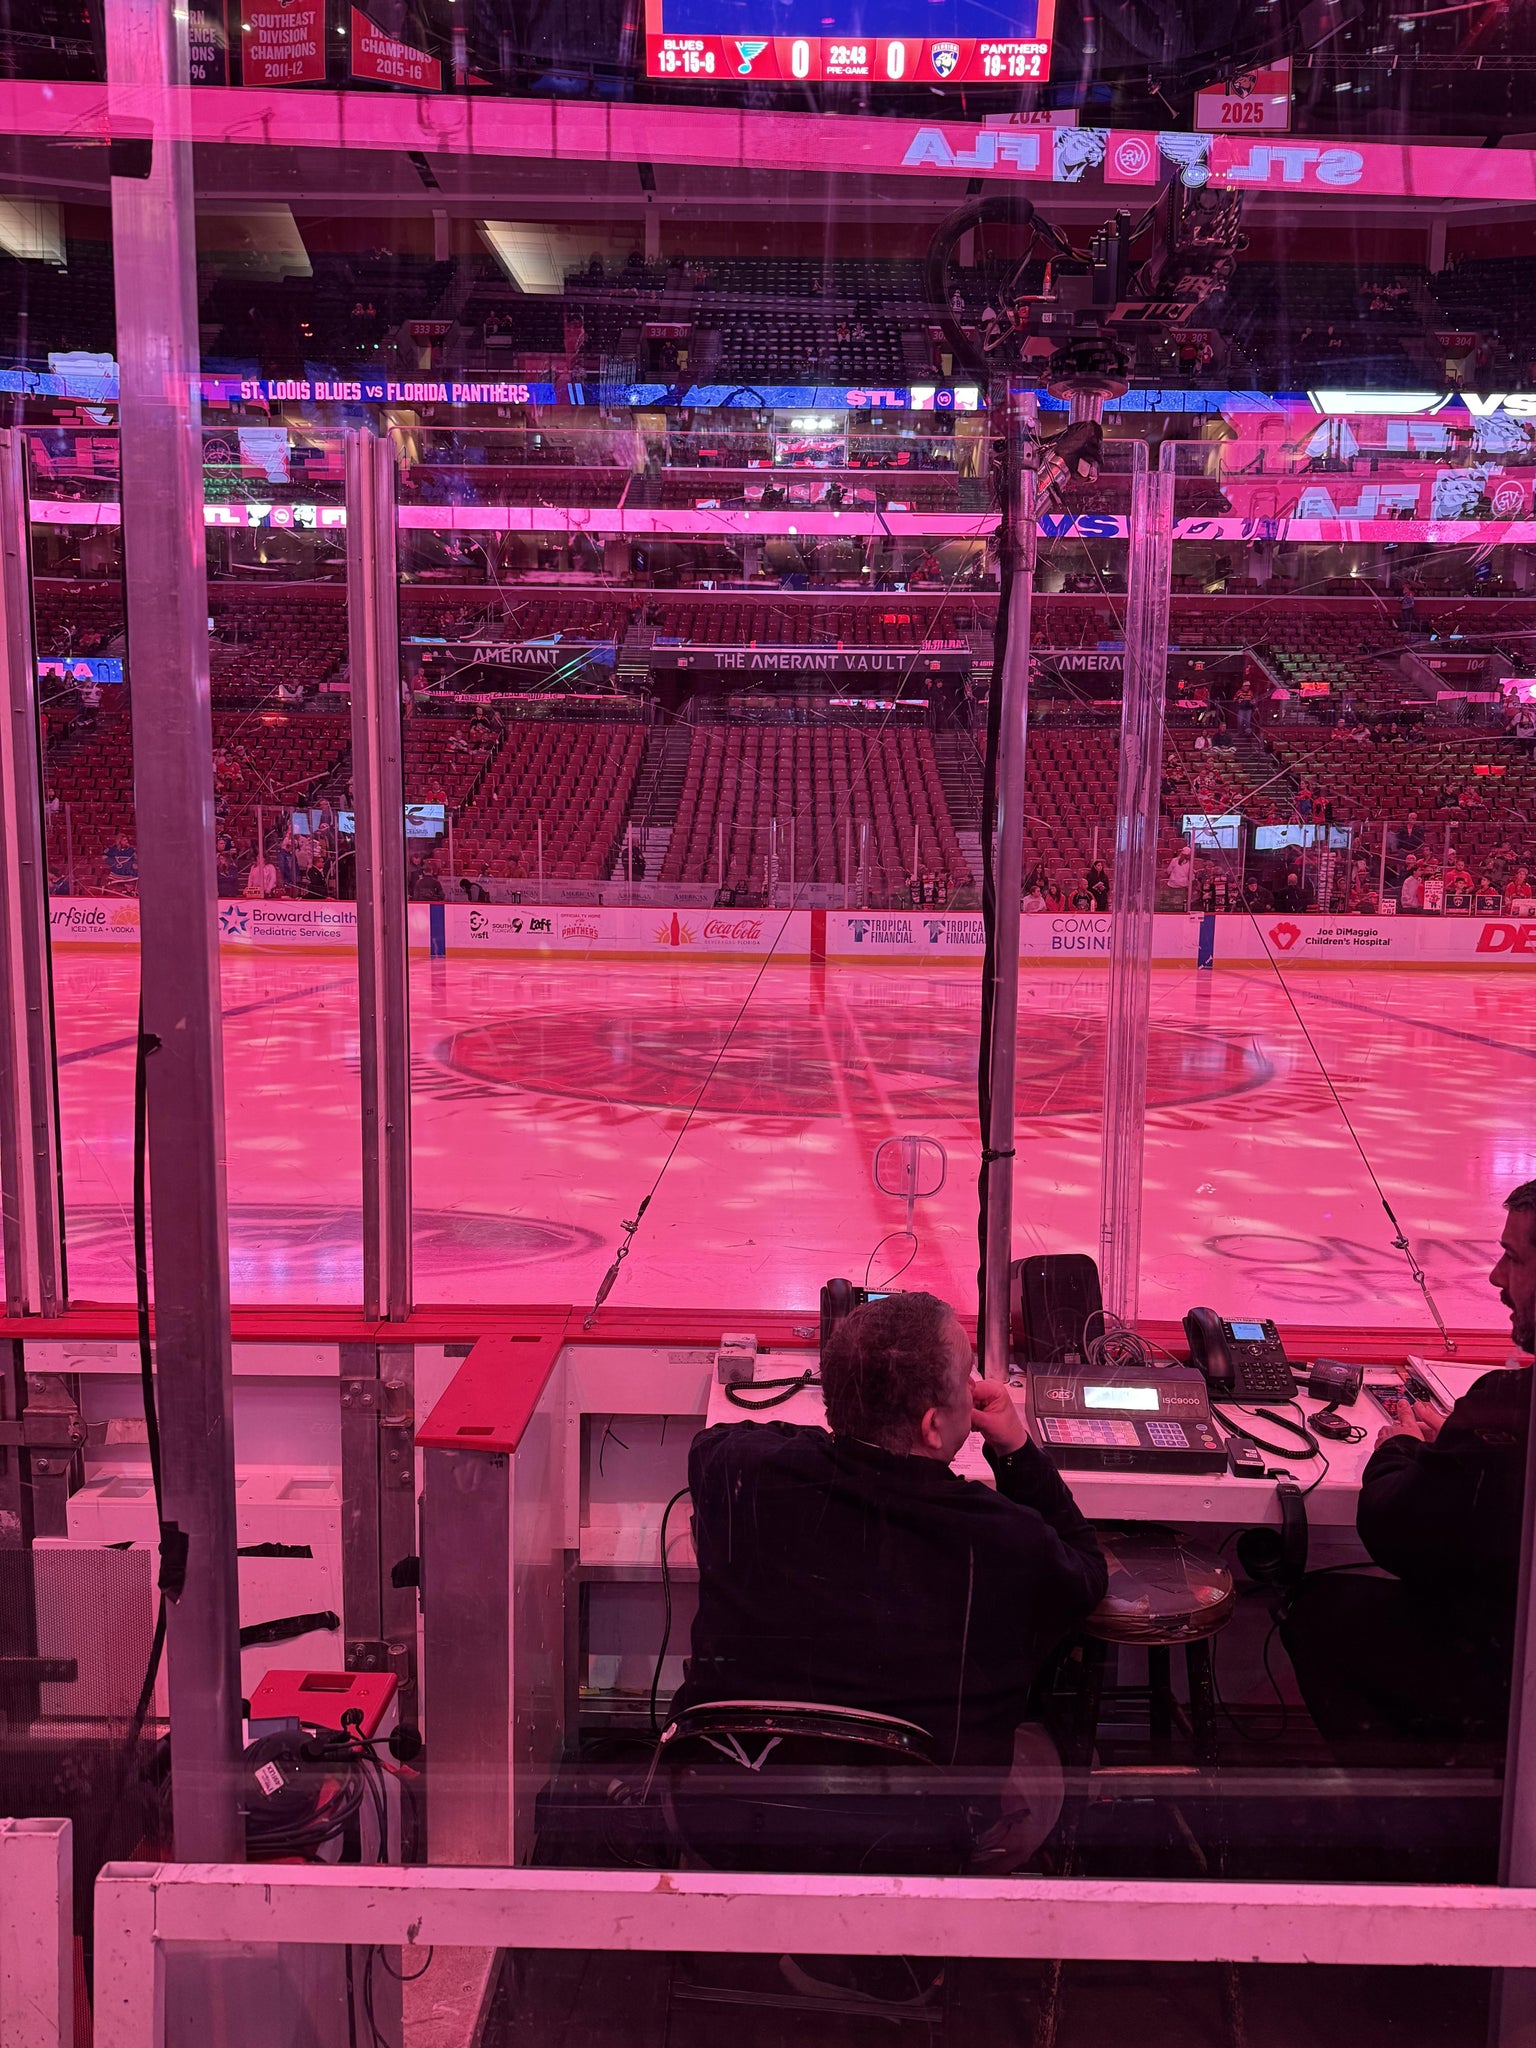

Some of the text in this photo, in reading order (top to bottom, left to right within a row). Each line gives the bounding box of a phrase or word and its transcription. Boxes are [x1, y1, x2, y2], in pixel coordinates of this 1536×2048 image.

[251, 11, 316, 29] SOUTHEAST
[259, 27, 308, 44] DIVISION
[251, 42, 316, 60] CHAMPIONS
[361, 38, 432, 64] CHAMPIONS
[664, 40, 704, 51] BLUES
[981, 43, 1048, 55] PANTHERS
[658, 51, 715, 73] 13-15-8
[792, 39, 810, 79] 0
[830, 45, 867, 65] 23:43
[886, 40, 905, 80] 0
[265, 61, 303, 78] 2011-12
[376, 58, 422, 80] 2015-16
[826, 66, 869, 75] PRE-GAME
[1221, 102, 1264, 123] 2025
[241, 382, 264, 399] ST.
[269, 381, 310, 400] LOUIS
[315, 382, 361, 400] BLUES
[387, 383, 448, 402] FLORIDA
[452, 383, 528, 403] PANTHERS
[846, 390, 905, 406] STL
[1038, 514, 1120, 538] VS
[474, 649, 560, 664] AMERANT
[715, 653, 906, 670] THE AMERANT VAULT
[1059, 655, 1124, 670] AMERA
[253, 909, 357, 924] Broward Health
[253, 926, 341, 938] Pediatric Services
[561, 926, 599, 940] PANTHERS
[703, 919, 766, 940] Coca-Cola
[871, 919, 913, 932] TROPICAL
[946, 920, 985, 933] TROPICA
[1317, 928, 1378, 937] Joe DiMaggio
[946, 932, 986, 944] FINANCIA
[1305, 937, 1391, 946] Children's Hospital
[1162, 1397, 1200, 1405] ISC9000
